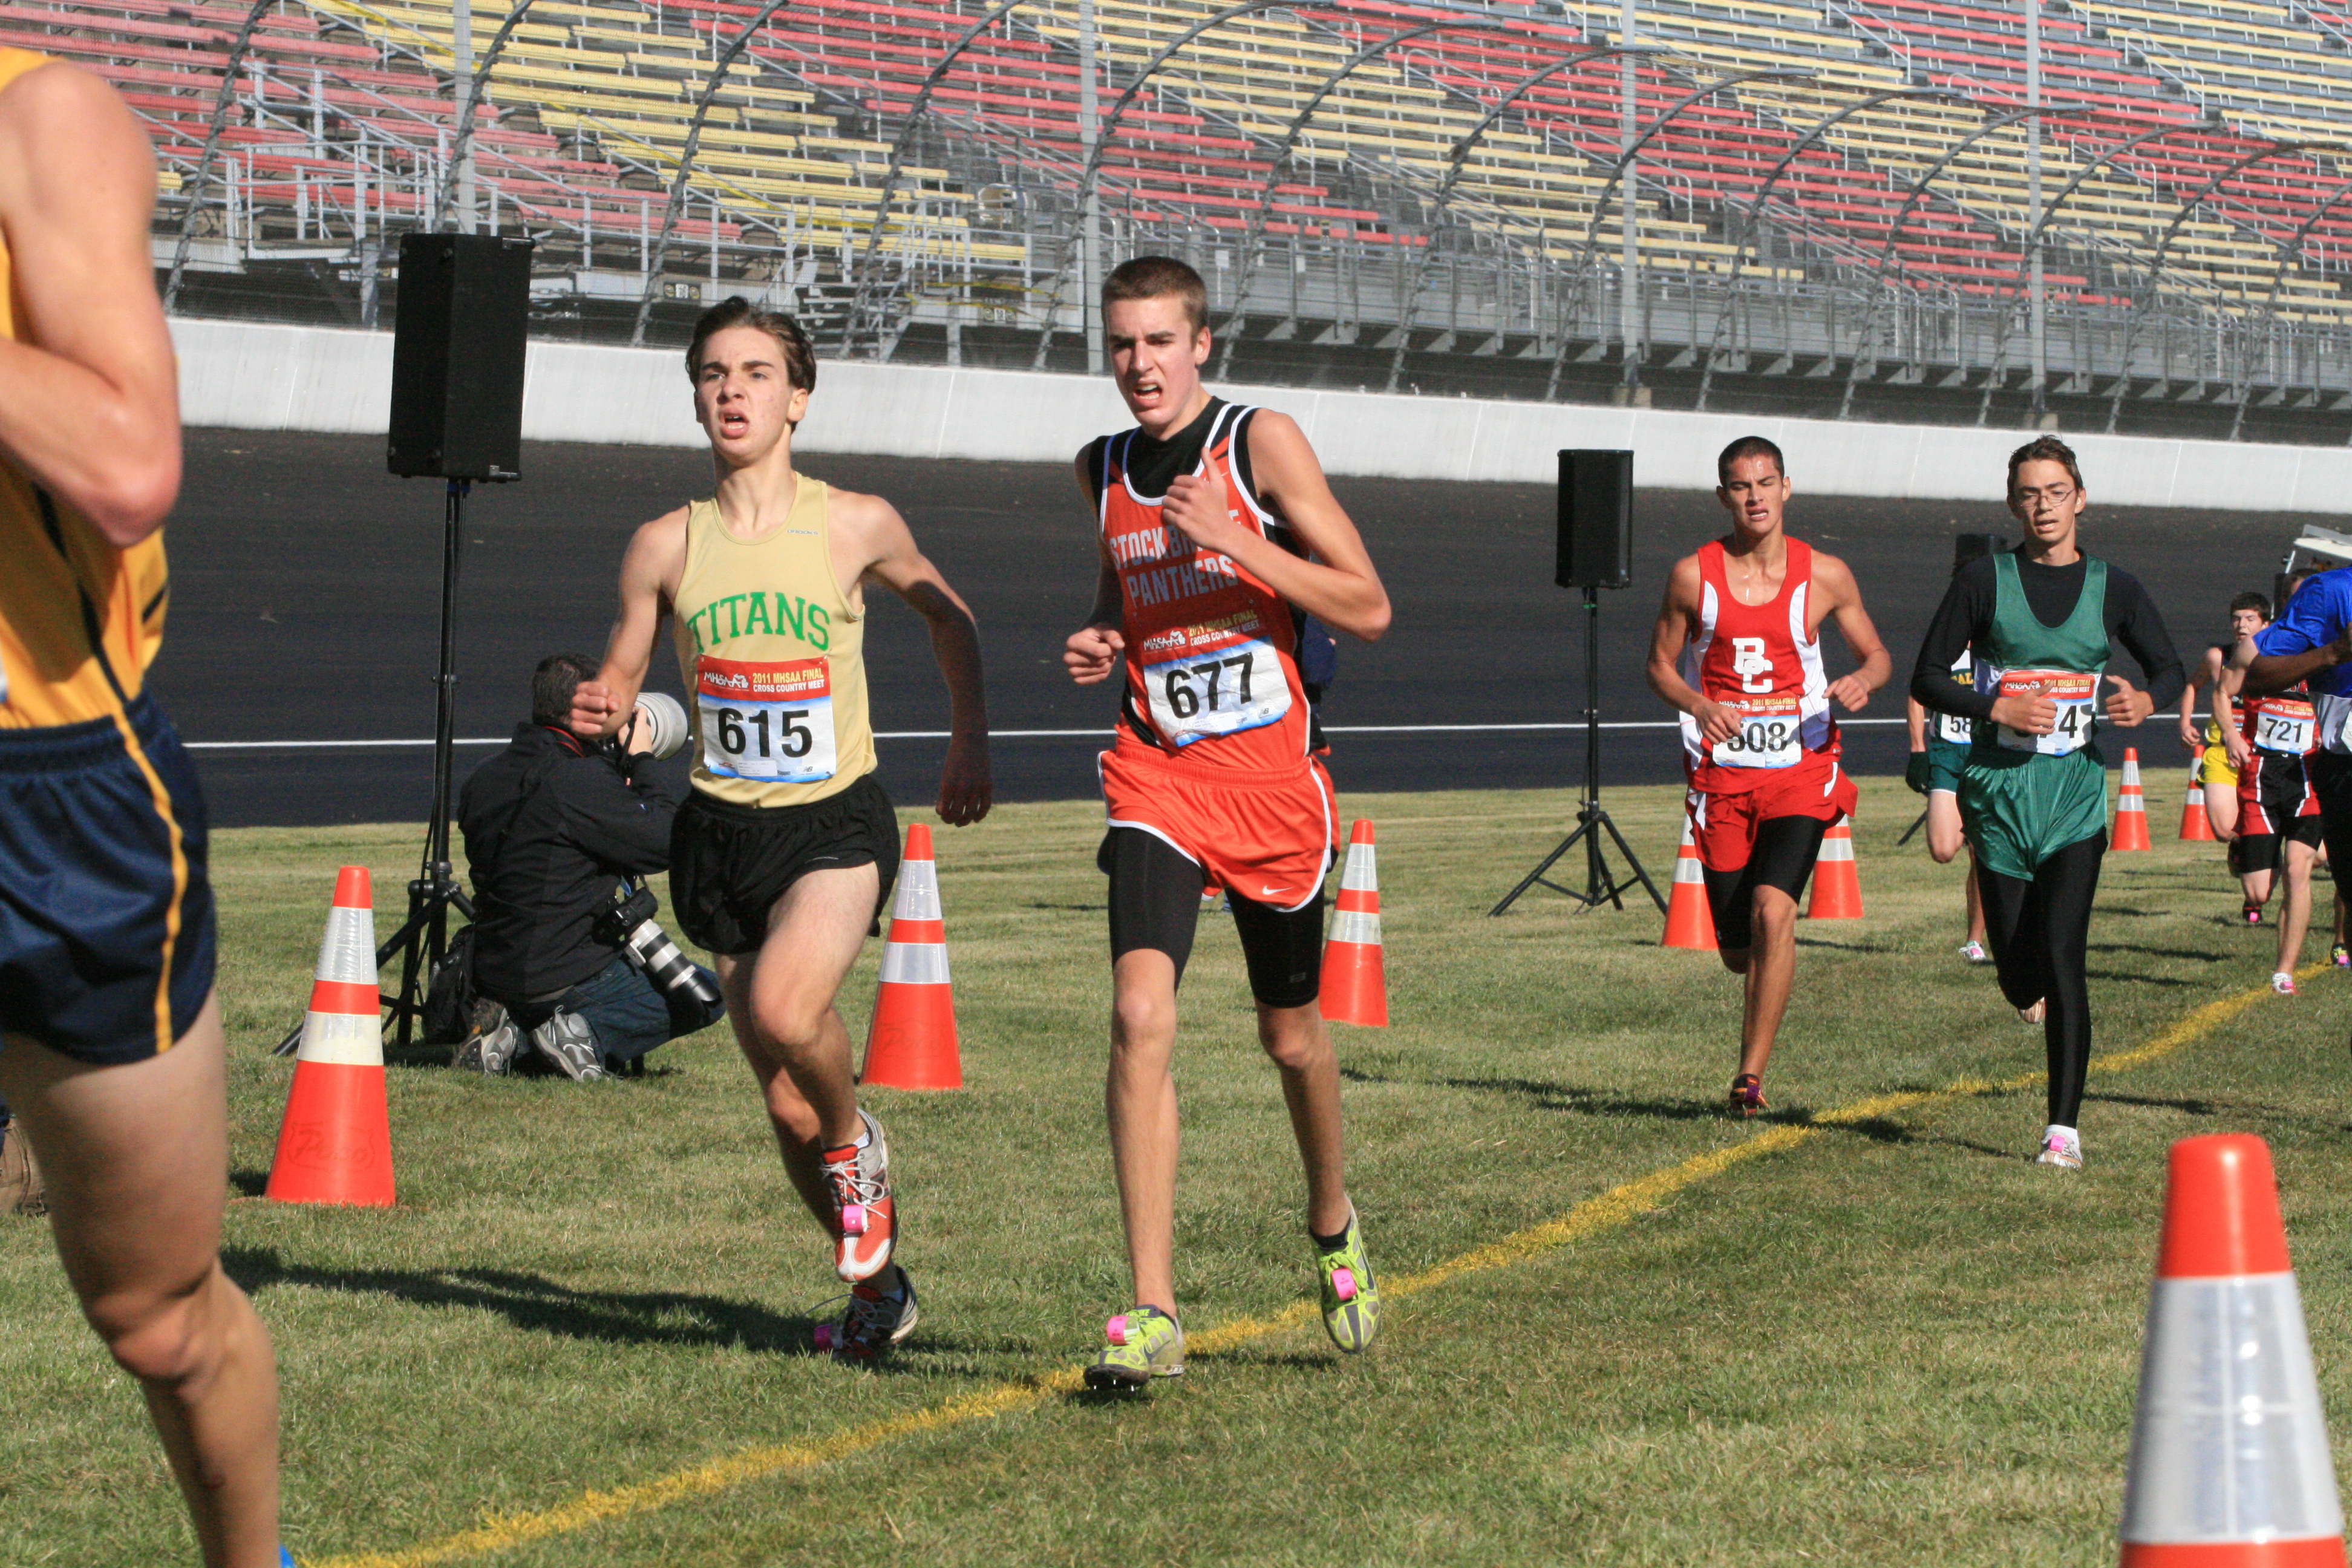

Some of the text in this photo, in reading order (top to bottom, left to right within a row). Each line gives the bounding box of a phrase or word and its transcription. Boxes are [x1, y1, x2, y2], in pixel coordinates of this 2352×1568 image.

[1127, 555, 1238, 608] PANTHERS
[687, 592, 830, 653] TITANS
[1187, 626, 1206, 637] 2011
[1232, 609, 1258, 624] FINAL
[1190, 619, 1260, 647] CROSS COUNTRY MEET
[752, 668, 824, 684] 2011 MHSAA FINAL
[776, 683, 807, 692] COUNTRY
[808, 679, 825, 688] MEET
[1165, 652, 1254, 719] 677
[718, 708, 812, 757] 615
[1727, 722, 1788, 753] 508
[2265, 717, 2302, 743] 721
